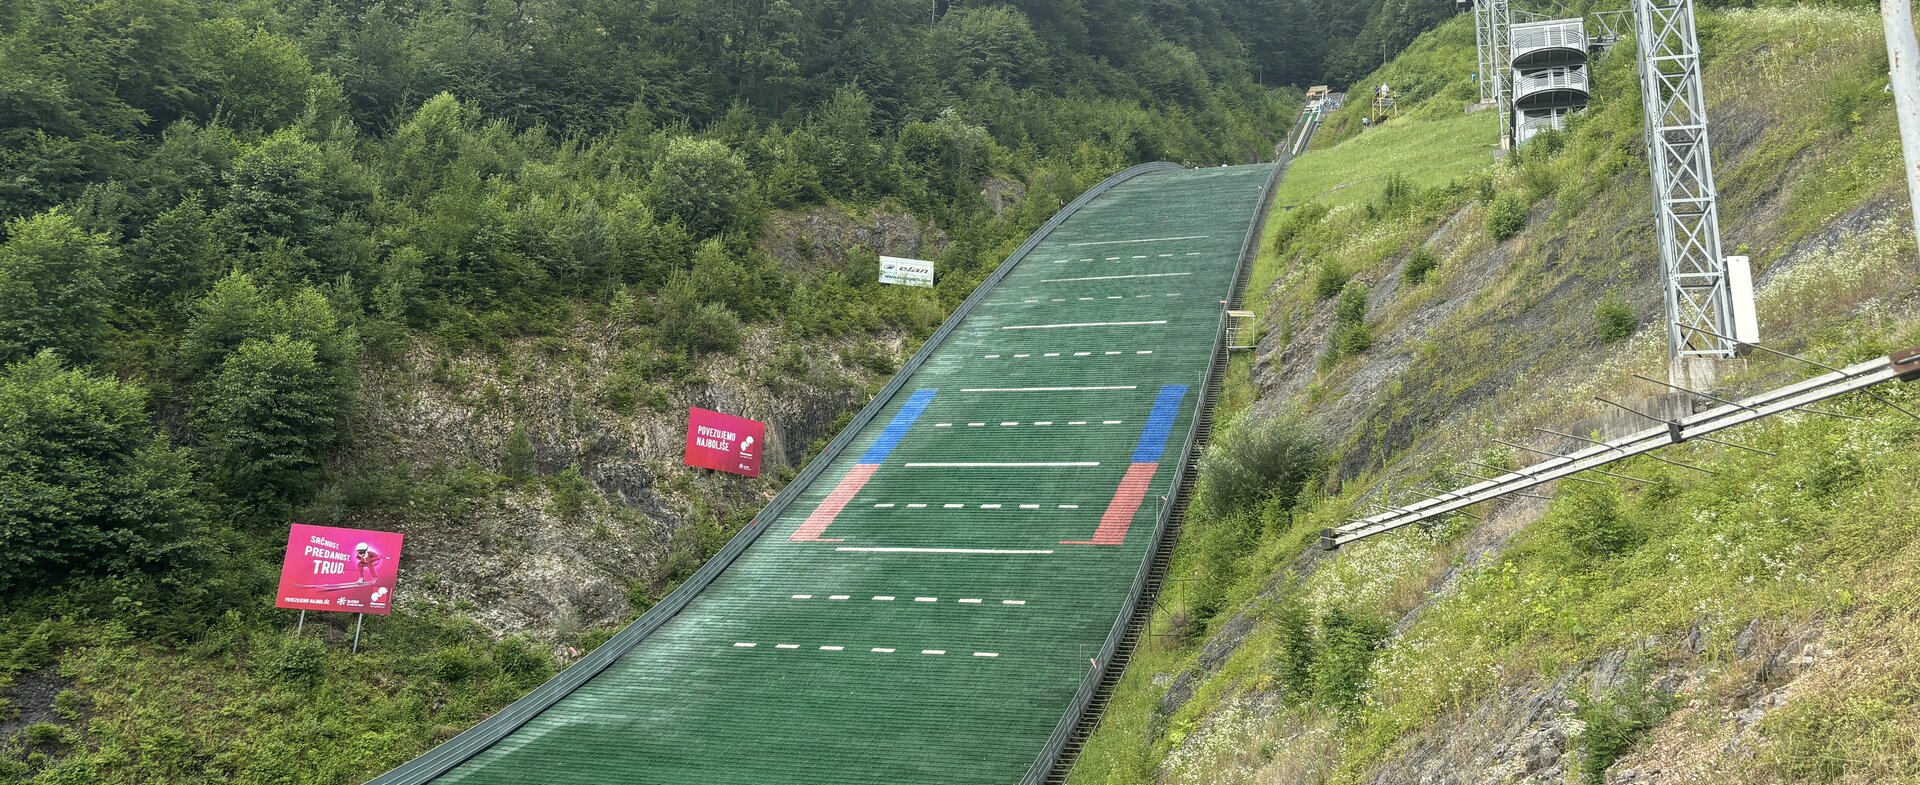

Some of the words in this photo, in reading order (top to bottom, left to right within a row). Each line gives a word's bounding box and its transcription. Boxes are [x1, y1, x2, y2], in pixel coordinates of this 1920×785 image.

[899, 266, 929, 274] elan
[697, 425, 736, 442] POVEZUJEMO
[696, 436, 730, 452] NAJBOLJŠE.
[310, 535, 340, 550] SRČNOST.
[304, 545, 351, 562] PREDANOST.
[313, 560, 345, 575] TRUD.
